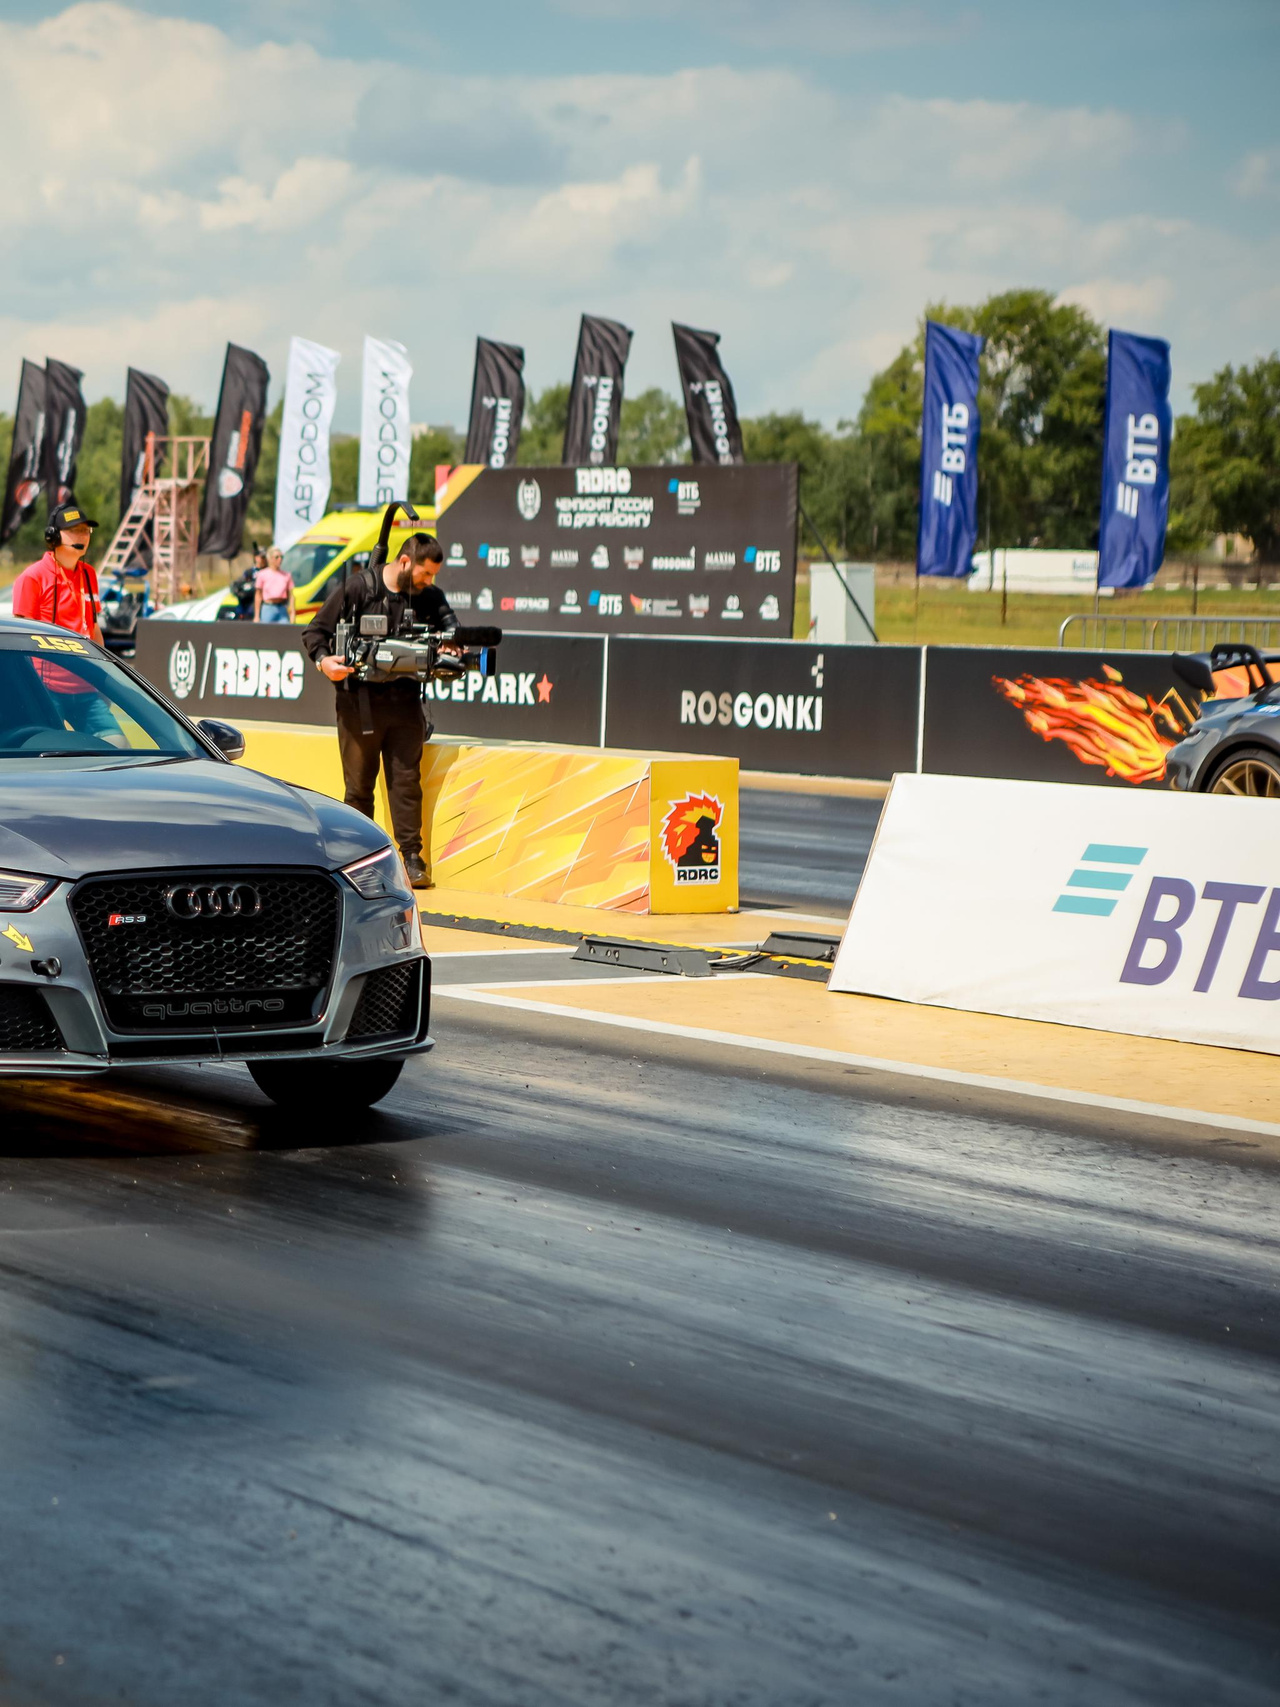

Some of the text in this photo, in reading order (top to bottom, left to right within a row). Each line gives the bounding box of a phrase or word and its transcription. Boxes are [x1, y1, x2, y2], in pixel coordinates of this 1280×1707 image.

[941, 402, 970, 474] ВТБ
[1125, 413, 1159, 485] ВТБ
[575, 467, 632, 495] RDRC
[677, 481, 700, 500] ВТБ
[486, 546, 510, 568] ВТБ
[754, 549, 781, 573] ВТБ
[598, 594, 623, 616] ВТБ
[30, 634, 90, 655] 152
[214, 647, 304, 700] RDRC
[680, 689, 823, 731] ROSGONKI
[677, 868, 719, 881] RDRC
[142, 997, 285, 1021] quattro
